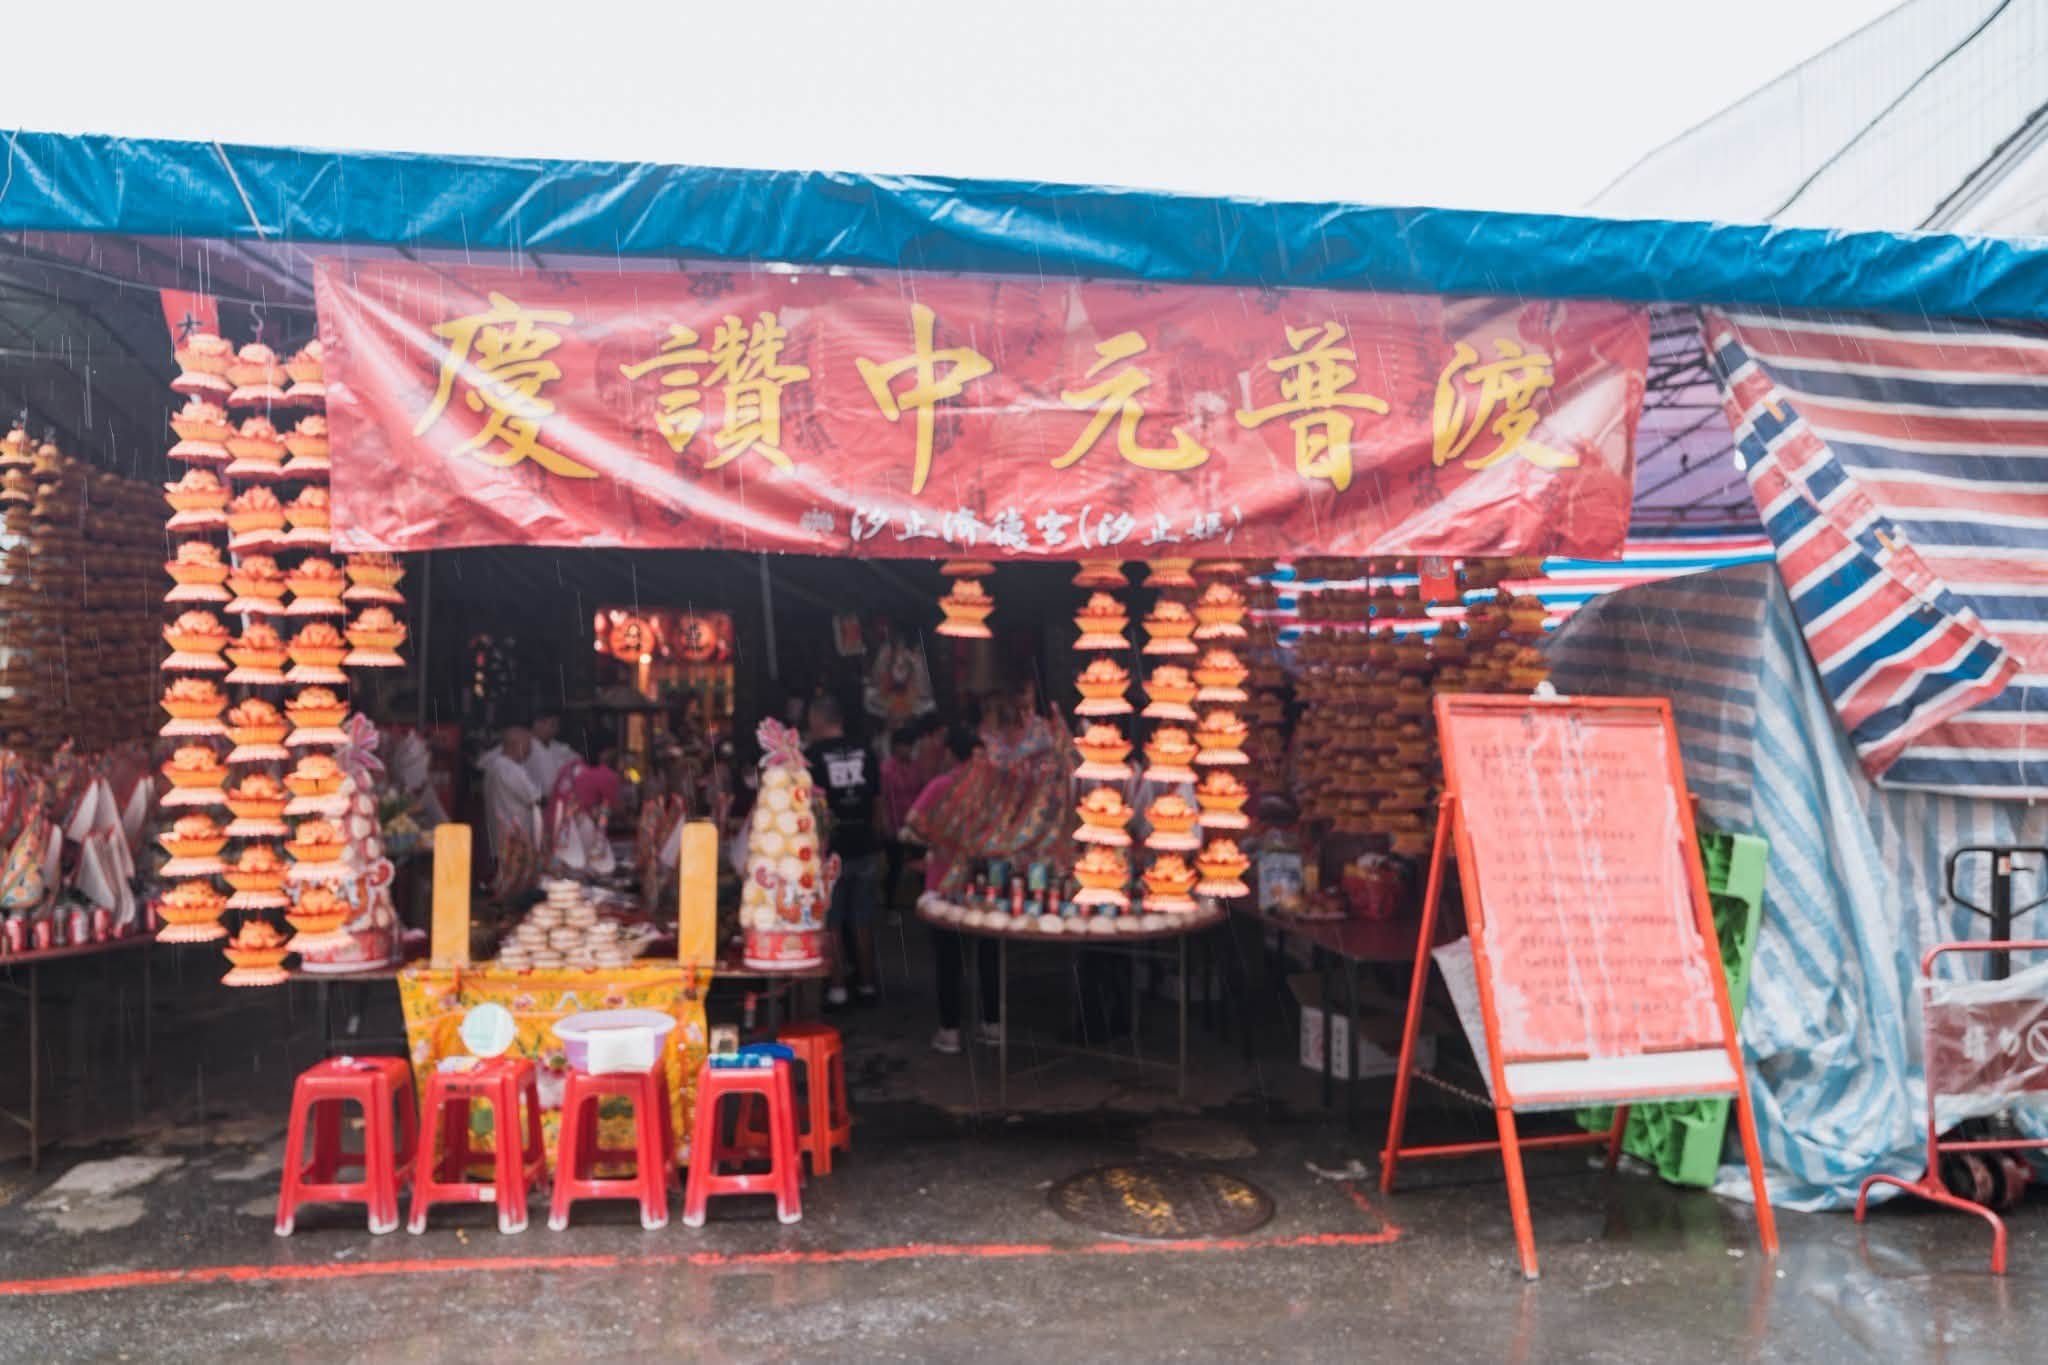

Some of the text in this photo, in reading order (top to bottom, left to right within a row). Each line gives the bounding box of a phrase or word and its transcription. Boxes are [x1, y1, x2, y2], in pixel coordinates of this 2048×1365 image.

[413, 290, 1580, 496] 慶讚中元普渡
